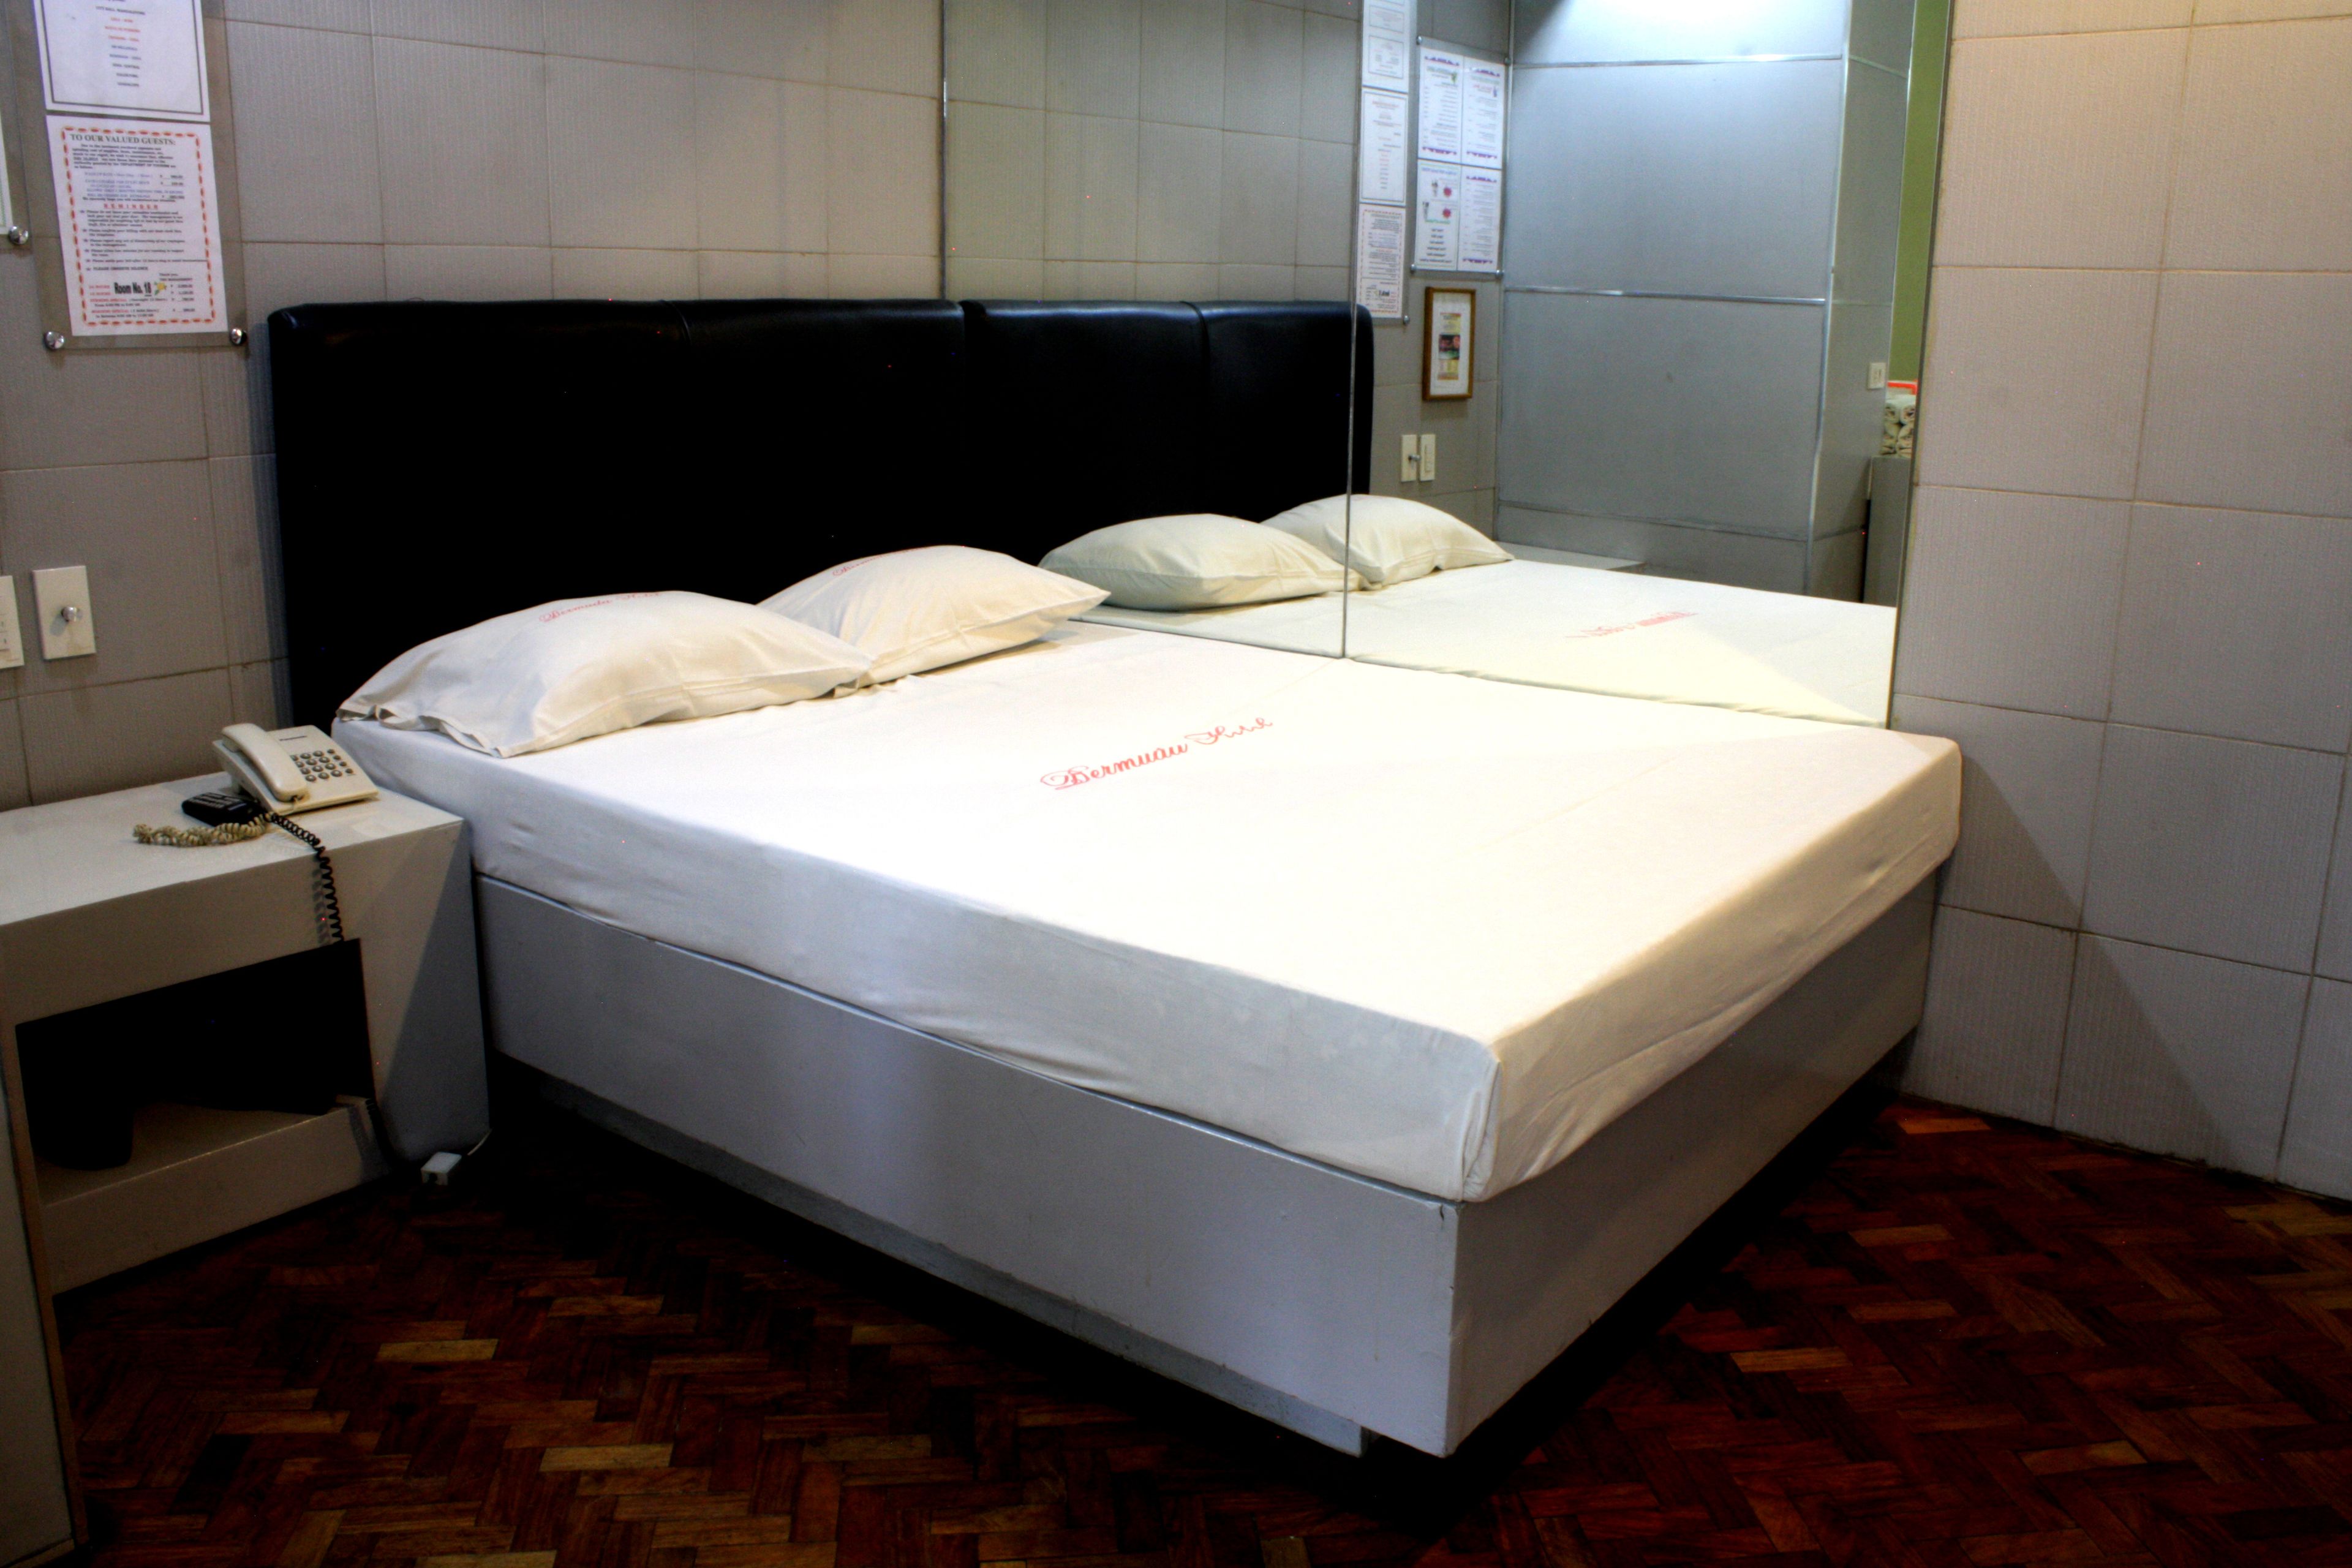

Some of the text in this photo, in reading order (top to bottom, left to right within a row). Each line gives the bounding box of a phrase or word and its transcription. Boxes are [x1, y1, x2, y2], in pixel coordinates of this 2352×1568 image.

[105, 135, 140, 144] VALUED
[114, 282, 132, 294] Room
[132, 282, 143, 294] No.
